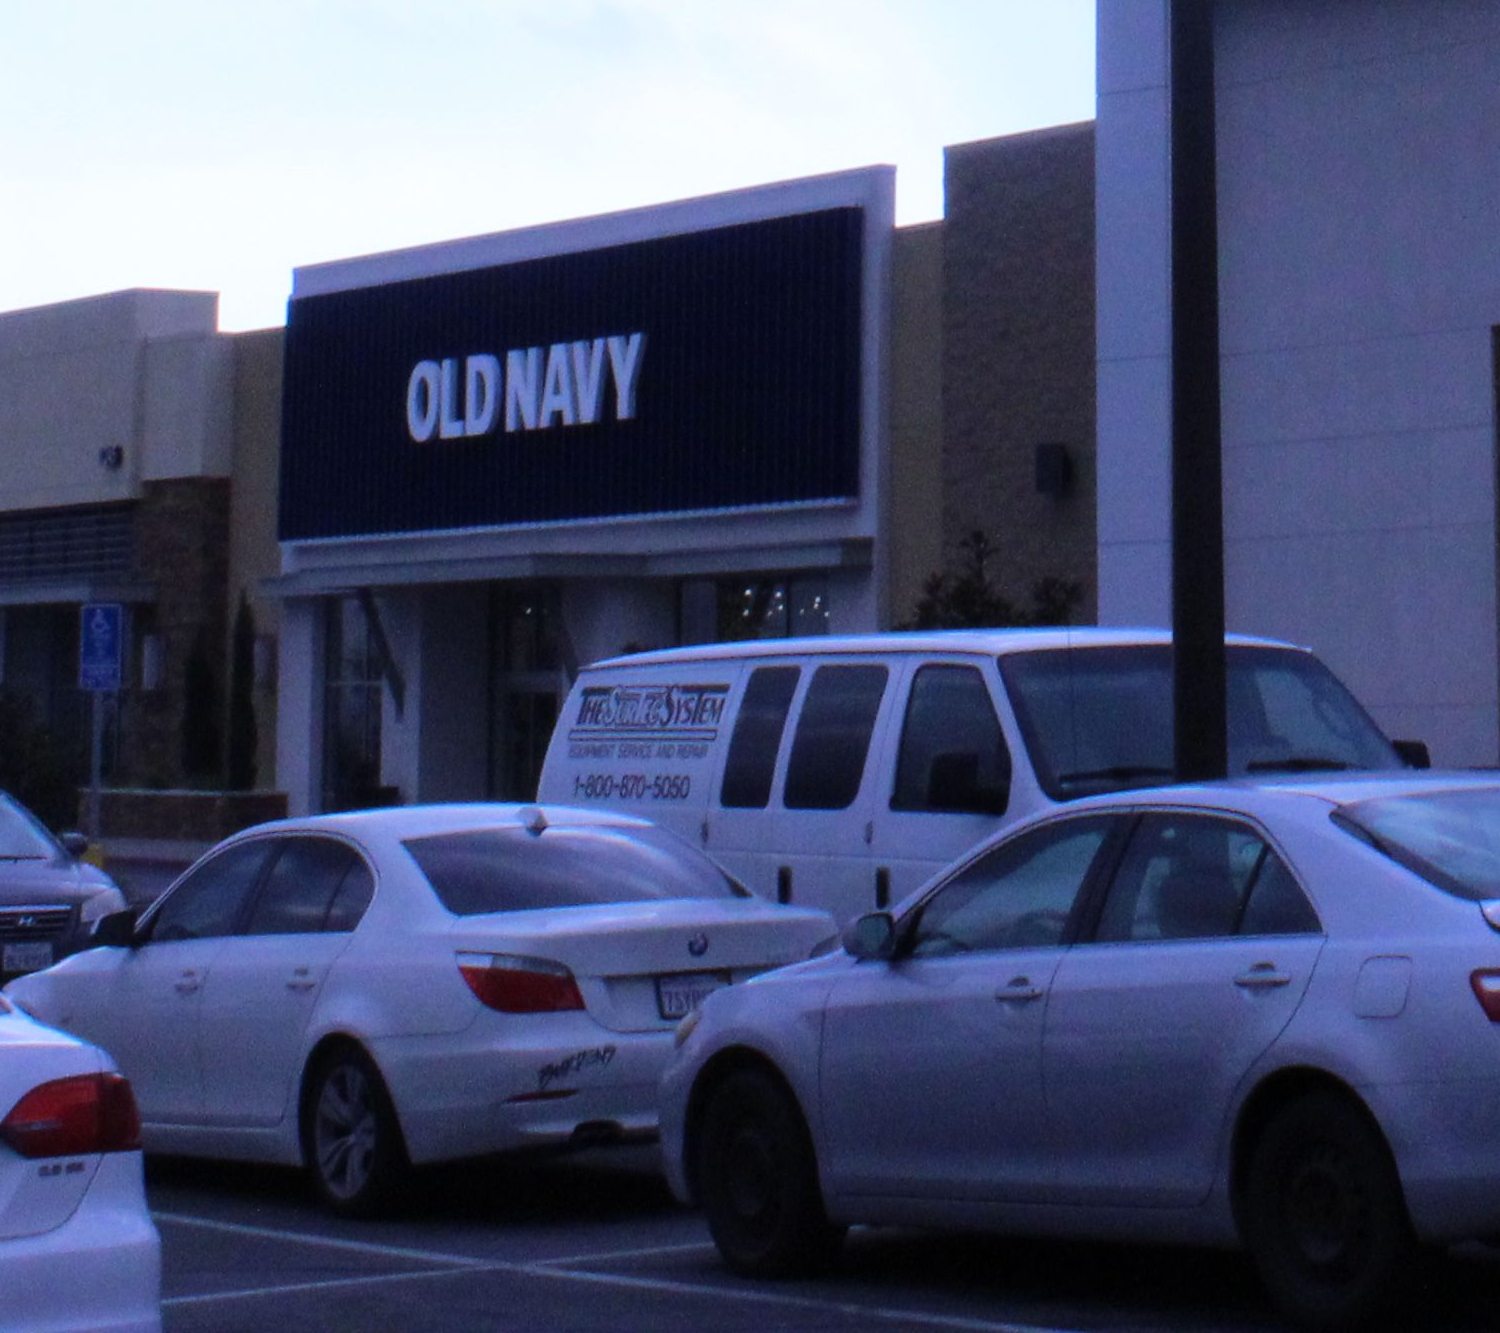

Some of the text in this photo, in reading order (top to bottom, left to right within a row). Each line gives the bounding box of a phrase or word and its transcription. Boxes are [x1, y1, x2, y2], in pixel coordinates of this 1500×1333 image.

[406, 333, 645, 442] OLD NAVY
[574, 774, 691, 799] 1-800-870-5050
